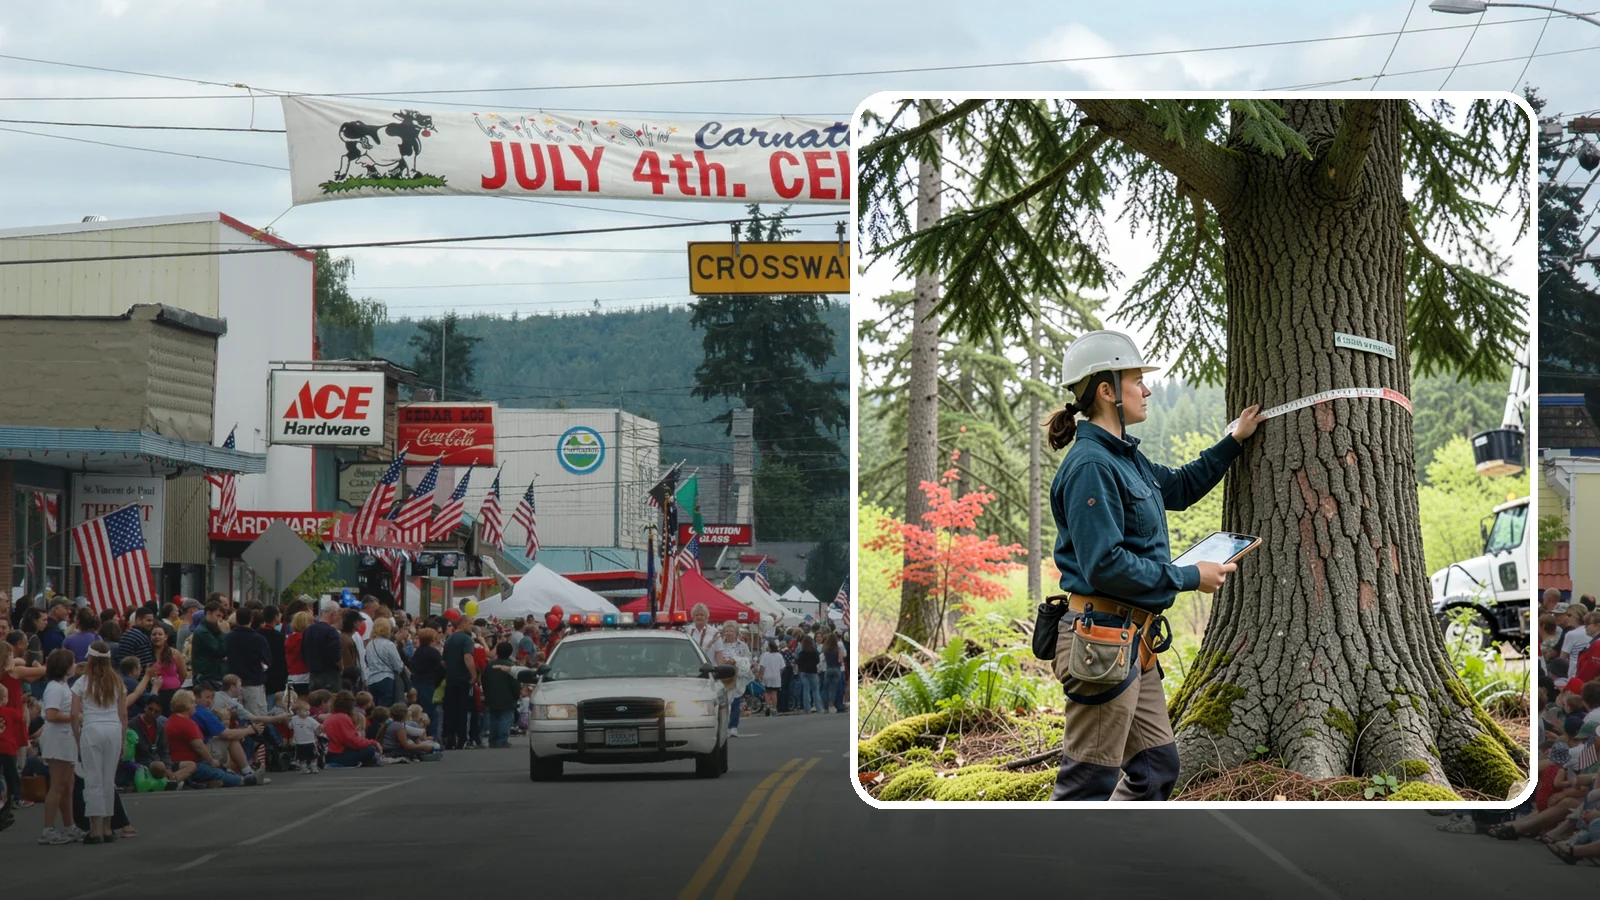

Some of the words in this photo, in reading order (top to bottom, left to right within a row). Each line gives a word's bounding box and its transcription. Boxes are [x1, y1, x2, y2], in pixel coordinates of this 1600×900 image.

[481, 141, 604, 192] JULY
[632, 149, 746, 198] 4th.
[697, 254, 850, 280] CROSSWA
[283, 380, 373, 420] ACE
[405, 409, 452, 422] CEDAR
[283, 421, 370, 436] Hardware
[416, 428, 477, 447] Coca-Cola
[354, 467, 385, 480] Simpl
[83, 485, 93, 494] St.
[95, 485, 124, 494] Vincent
[126, 486, 136, 494] de
[138, 486, 155, 495] Paul
[688, 526, 741, 535] CRNATION
[699, 535, 730, 543] GLASS
